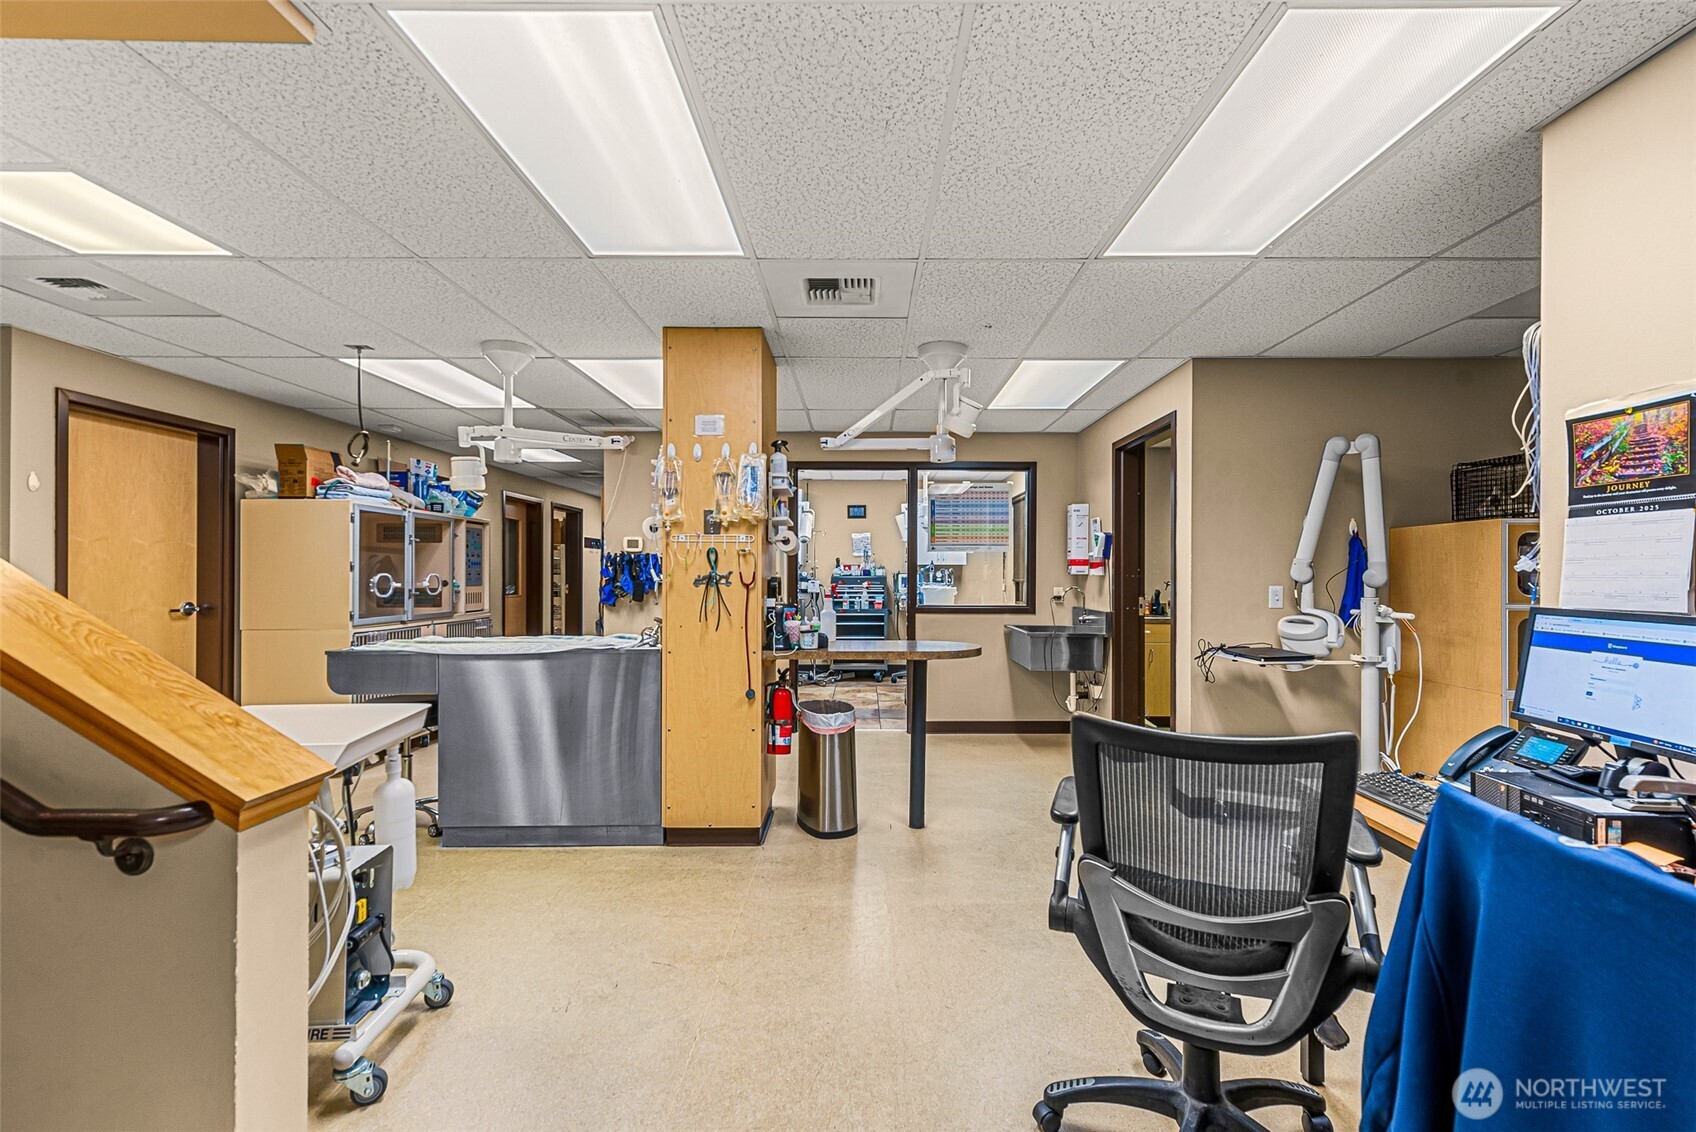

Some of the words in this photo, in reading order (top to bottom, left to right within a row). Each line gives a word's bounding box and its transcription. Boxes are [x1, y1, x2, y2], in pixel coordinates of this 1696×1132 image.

[1606, 481, 1651, 493] JOURNEY
[1596, 506, 1635, 515] OCTOBER
[1639, 504, 1660, 512] 2025
[308, 1028, 330, 1041] RE
